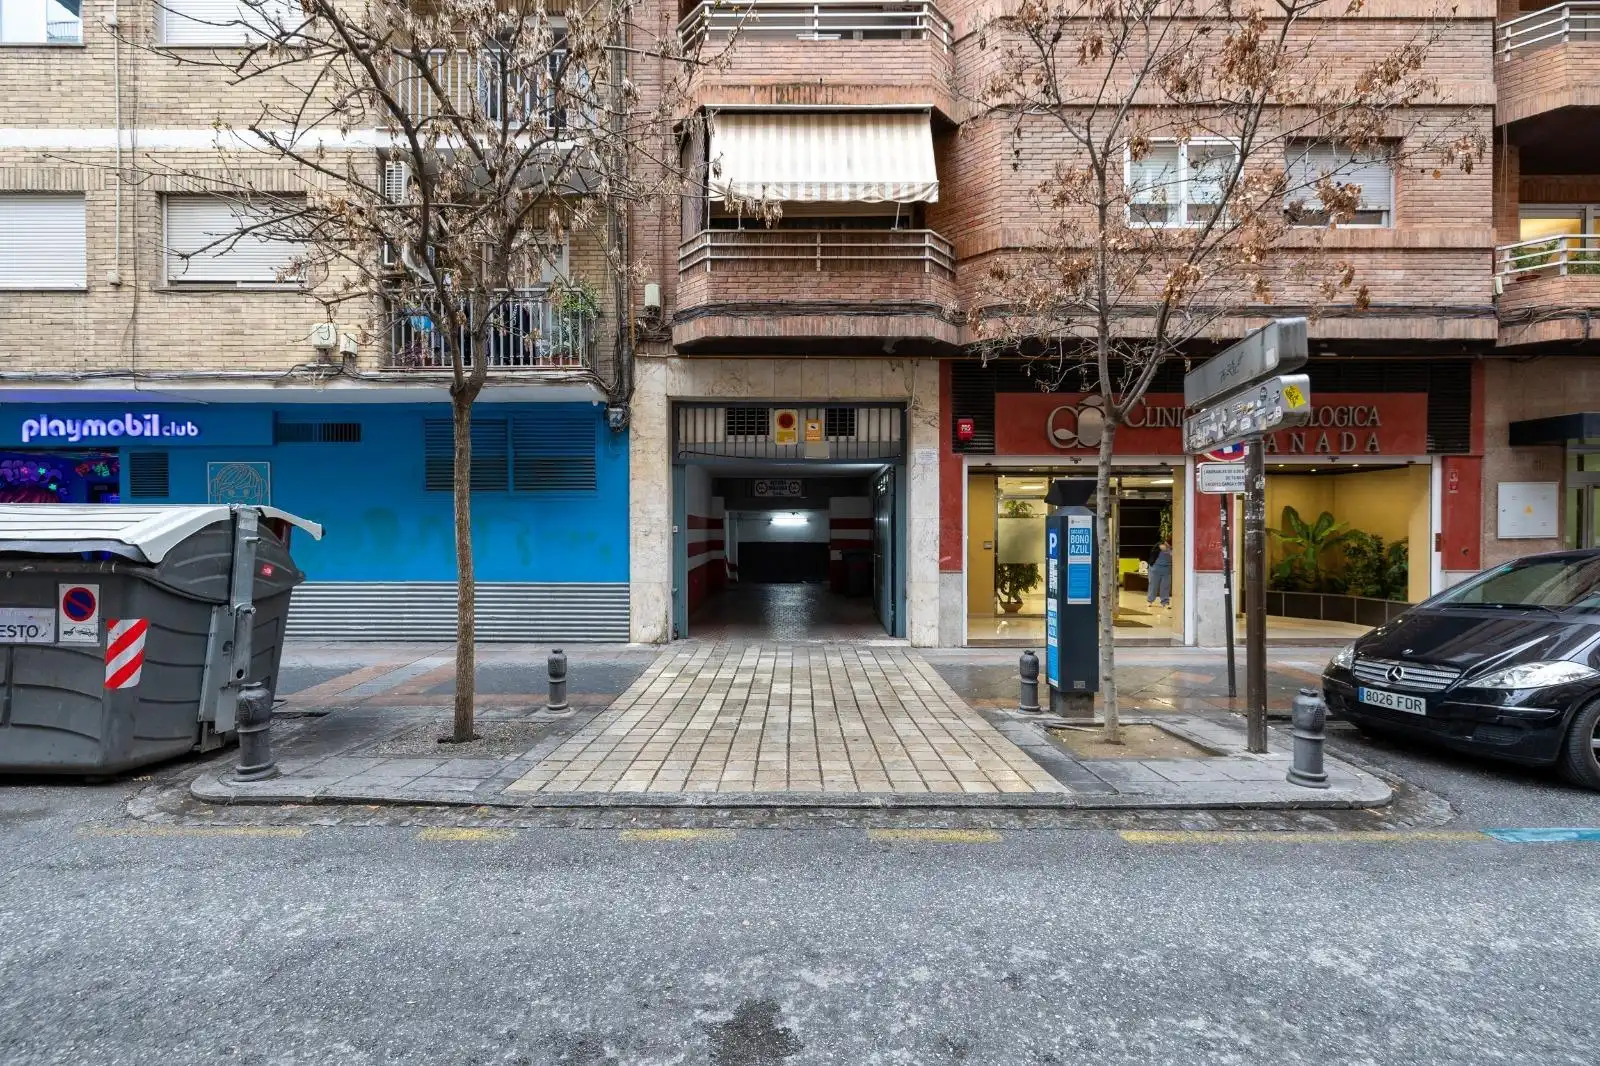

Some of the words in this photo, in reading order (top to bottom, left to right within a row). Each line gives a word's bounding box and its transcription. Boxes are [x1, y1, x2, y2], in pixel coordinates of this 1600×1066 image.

[22, 413, 159, 442] playmobil
[162, 421, 198, 436] club
[1265, 431, 1381, 453] ANADA
[1049, 533, 1058, 555] P
[1070, 534, 1090, 544] BONO
[1070, 544, 1090, 554] AZUL
[1366, 690, 1393, 706] 8026
[1397, 696, 1422, 712] FDR
